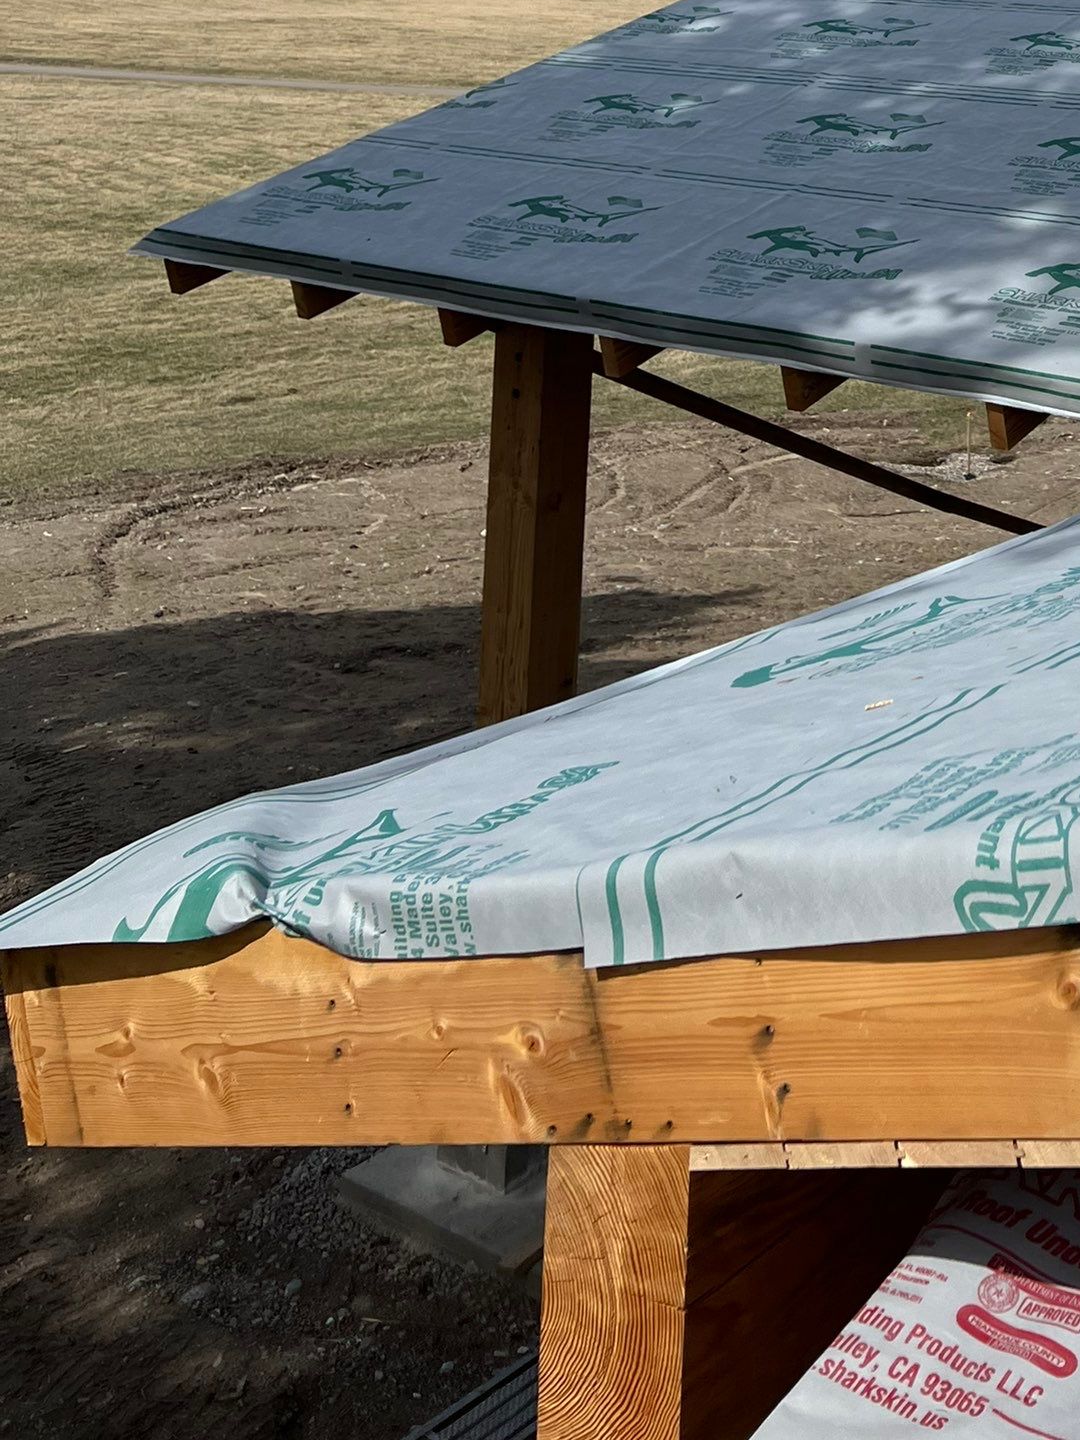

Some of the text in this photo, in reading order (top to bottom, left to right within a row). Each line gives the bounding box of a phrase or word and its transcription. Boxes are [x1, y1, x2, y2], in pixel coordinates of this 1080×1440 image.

[887, 1355, 921, 1388] CA
[919, 1371, 990, 1418] 93065
[904, 1323, 996, 1384] Products
[995, 1369, 1045, 1408] LLC
